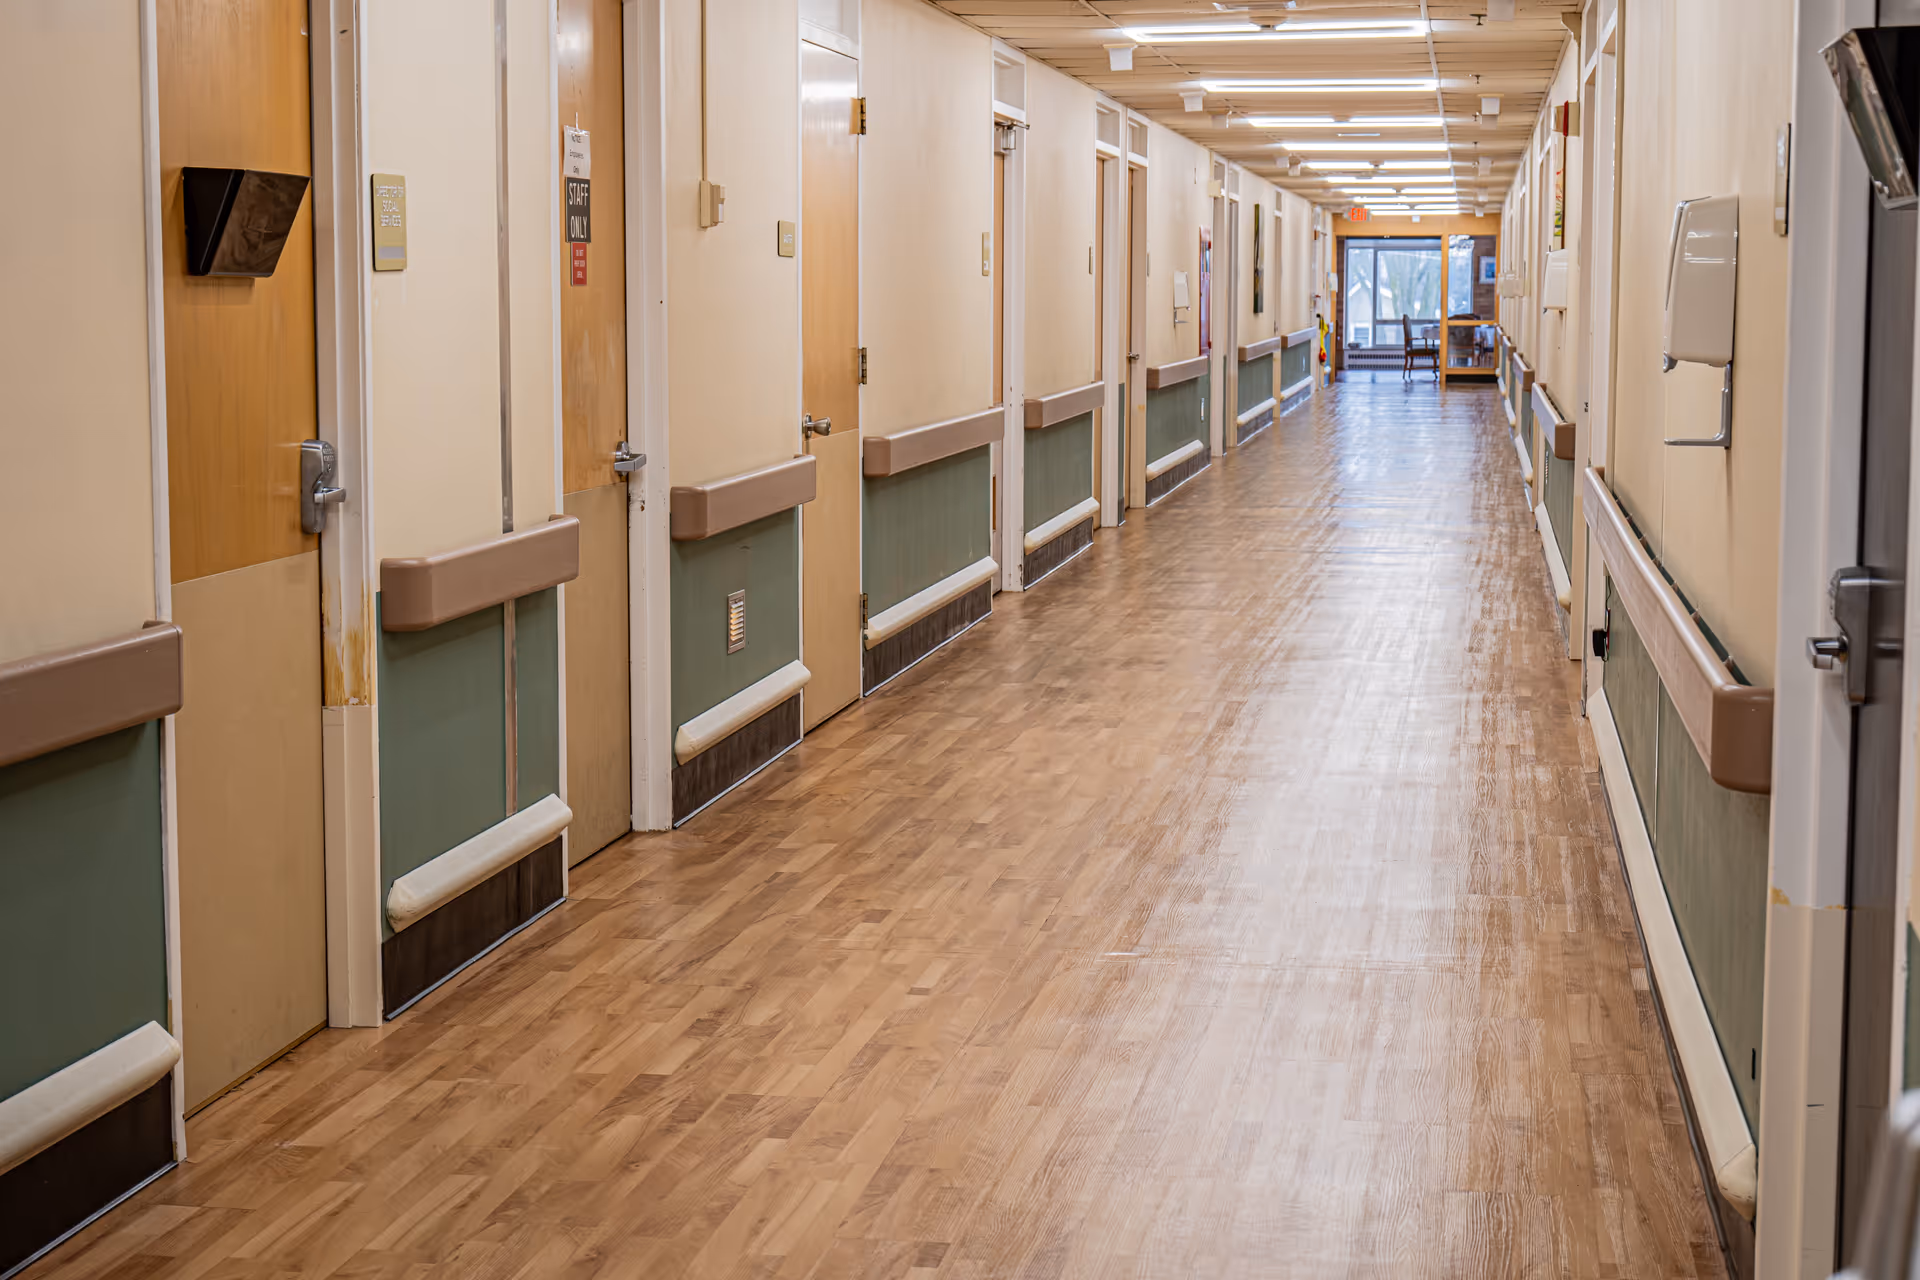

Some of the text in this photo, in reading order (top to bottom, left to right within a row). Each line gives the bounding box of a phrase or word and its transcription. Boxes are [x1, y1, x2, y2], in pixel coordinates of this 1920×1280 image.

[569, 182, 589, 206] STAFF
[1351, 207, 1368, 221] EXIT
[571, 215, 587, 239] ONLY
